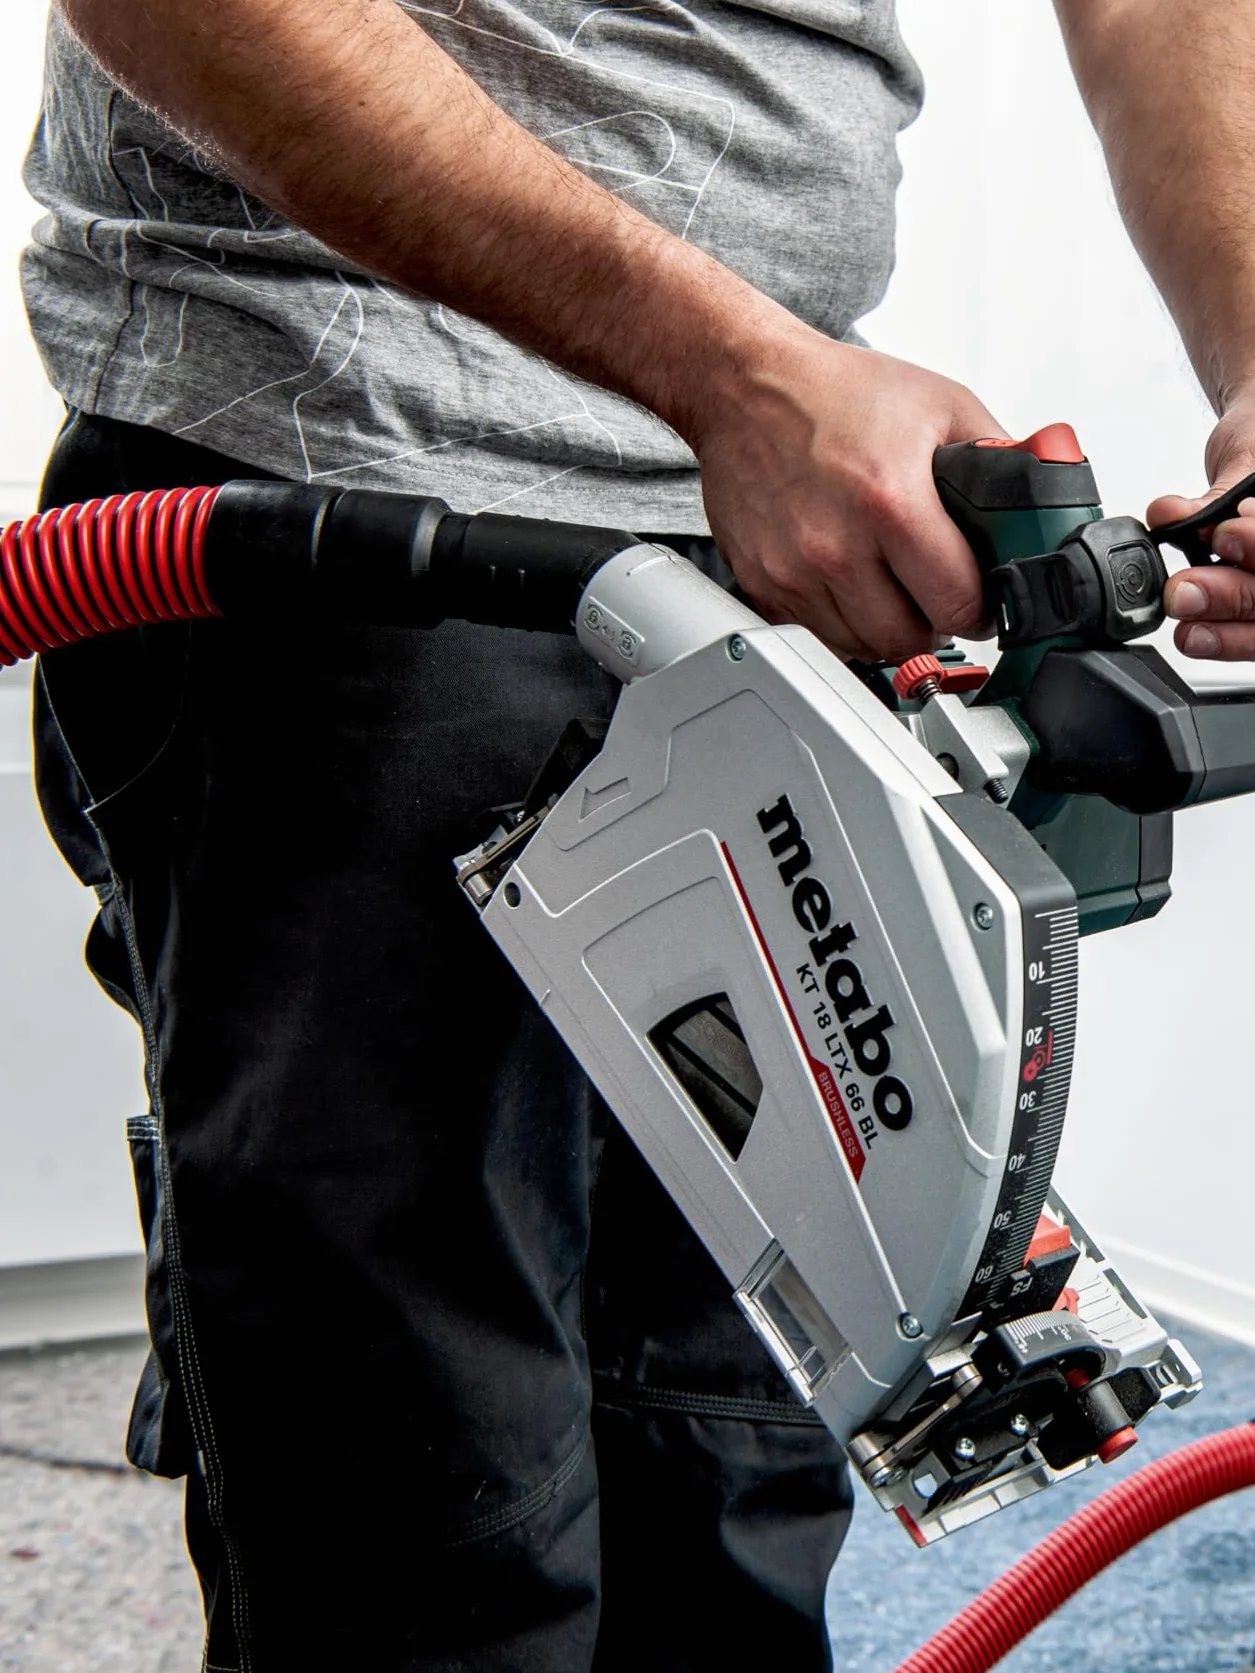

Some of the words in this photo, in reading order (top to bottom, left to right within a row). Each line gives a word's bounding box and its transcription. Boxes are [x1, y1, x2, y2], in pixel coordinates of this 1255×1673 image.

[757, 793, 912, 1131] metabo
[1028, 961, 1045, 981] 10
[1025, 1026, 1043, 1047] 20
[796, 963, 820, 994] KT
[813, 1001, 832, 1030] 18
[824, 1033, 853, 1080] LTX
[845, 1083, 865, 1112] 66
[858, 1115, 879, 1150] BL
[1019, 1090, 1037, 1111] 30
[818, 1071, 858, 1158] BRUSHLESS
[1008, 1153, 1026, 1172] 40
[994, 1210, 1012, 1229] 50
[974, 1265, 994, 1283] 60
[1010, 1277, 1033, 1297] FS
